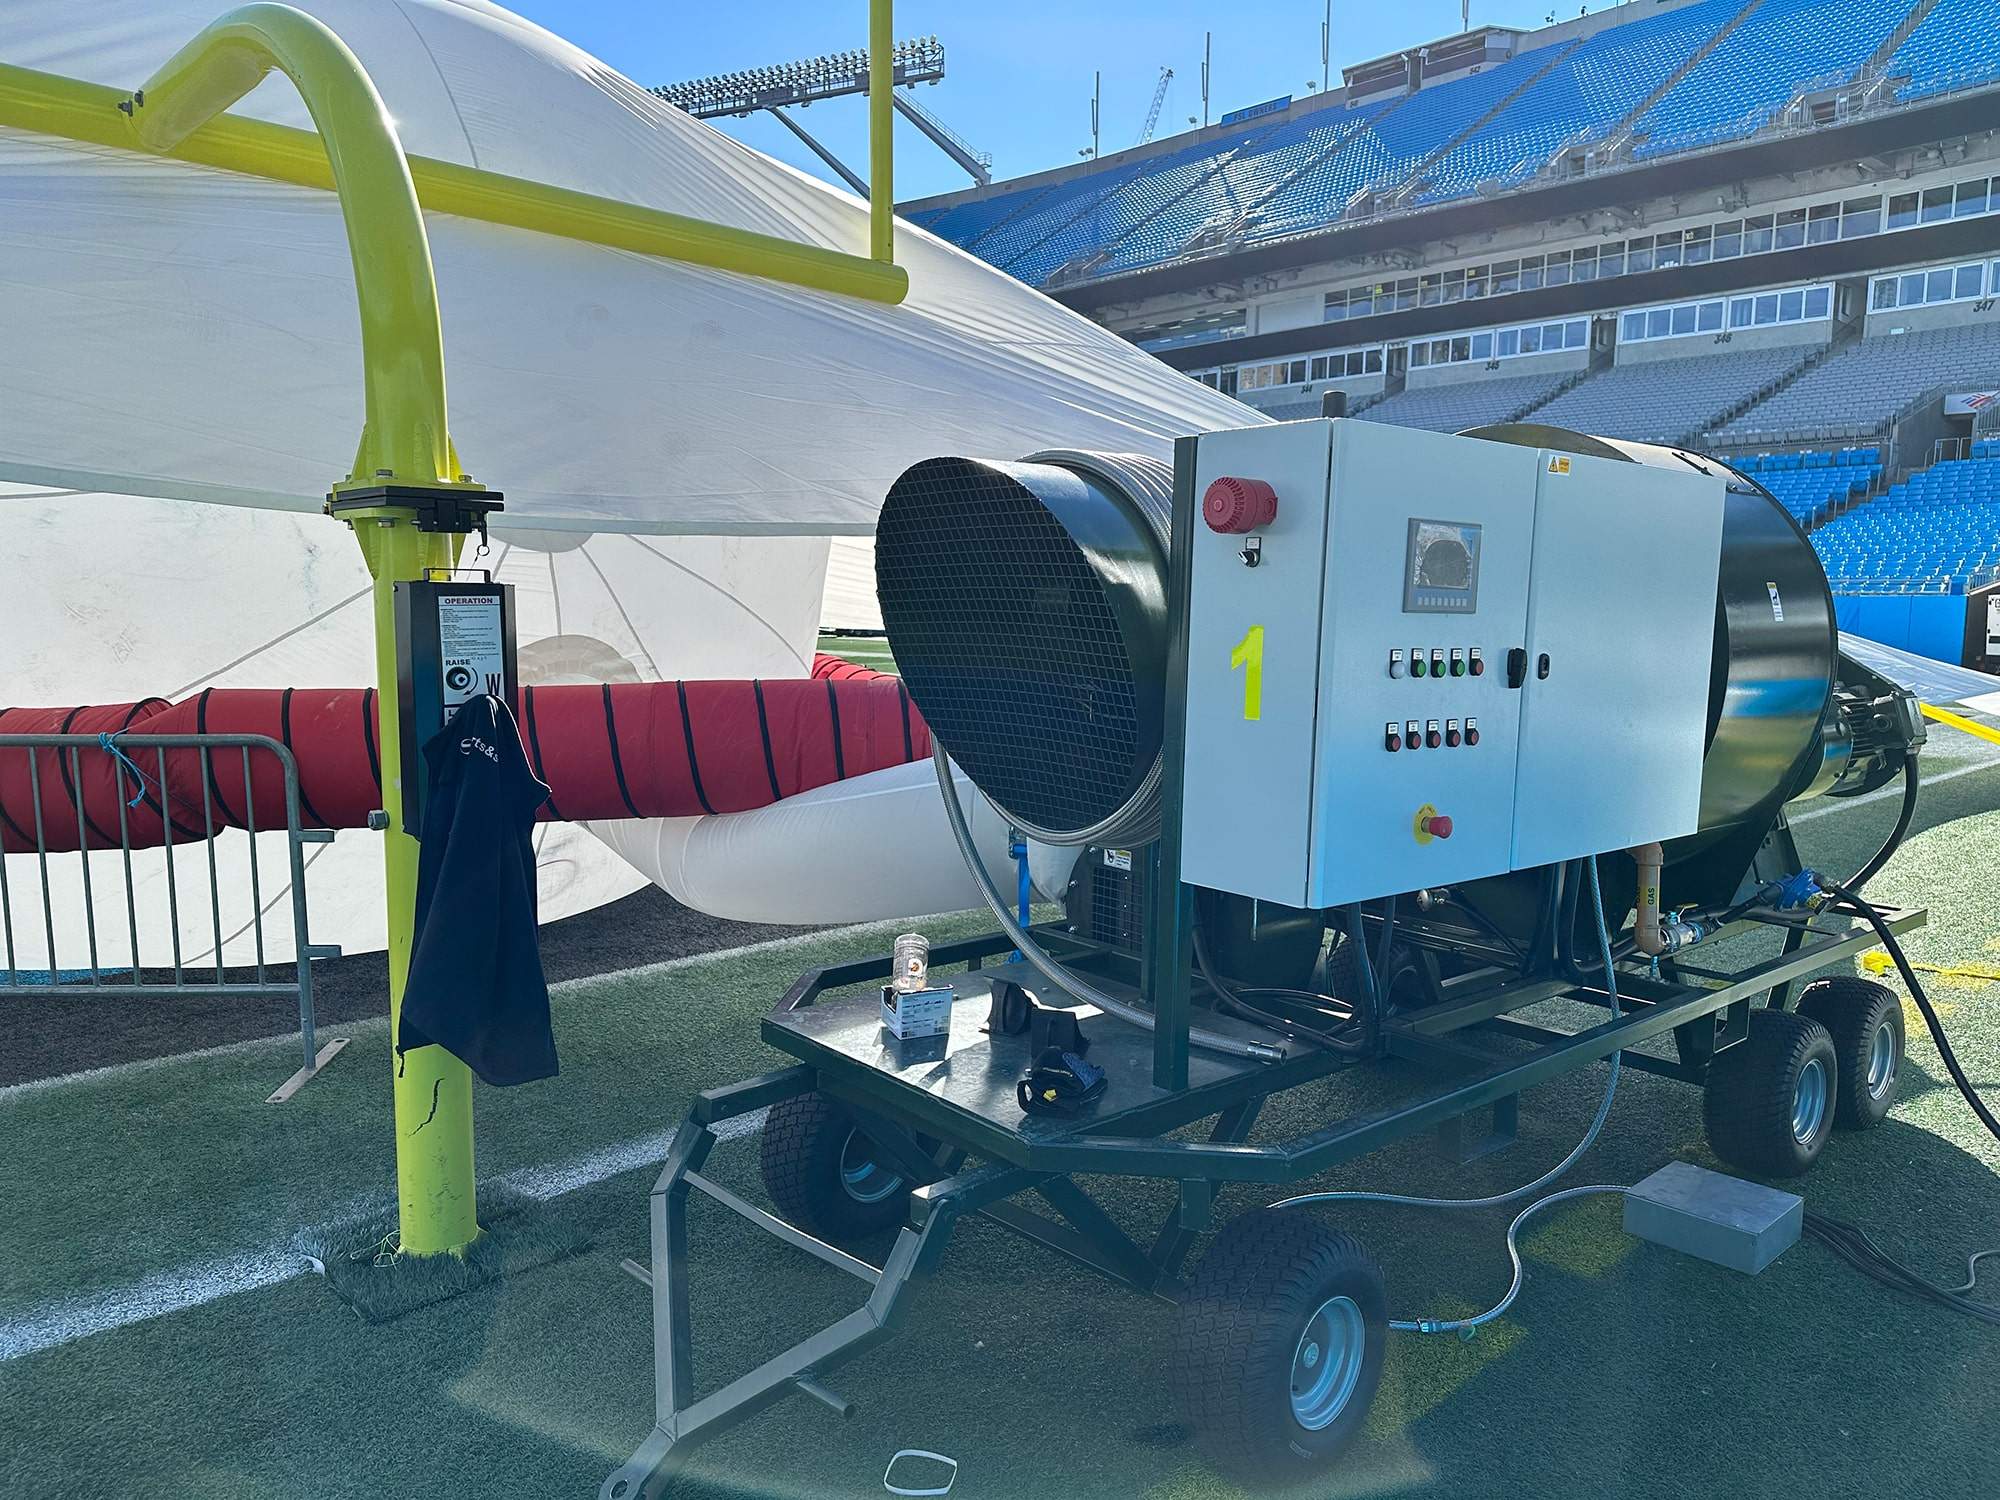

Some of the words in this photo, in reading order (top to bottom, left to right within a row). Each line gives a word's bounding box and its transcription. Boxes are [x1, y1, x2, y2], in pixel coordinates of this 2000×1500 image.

[1973, 299, 1996, 312] 347
[445, 658, 471, 666] RAISE
[1231, 624, 1265, 720] 1
[485, 673, 501, 697] W
[1647, 887, 1655, 905] GAS
